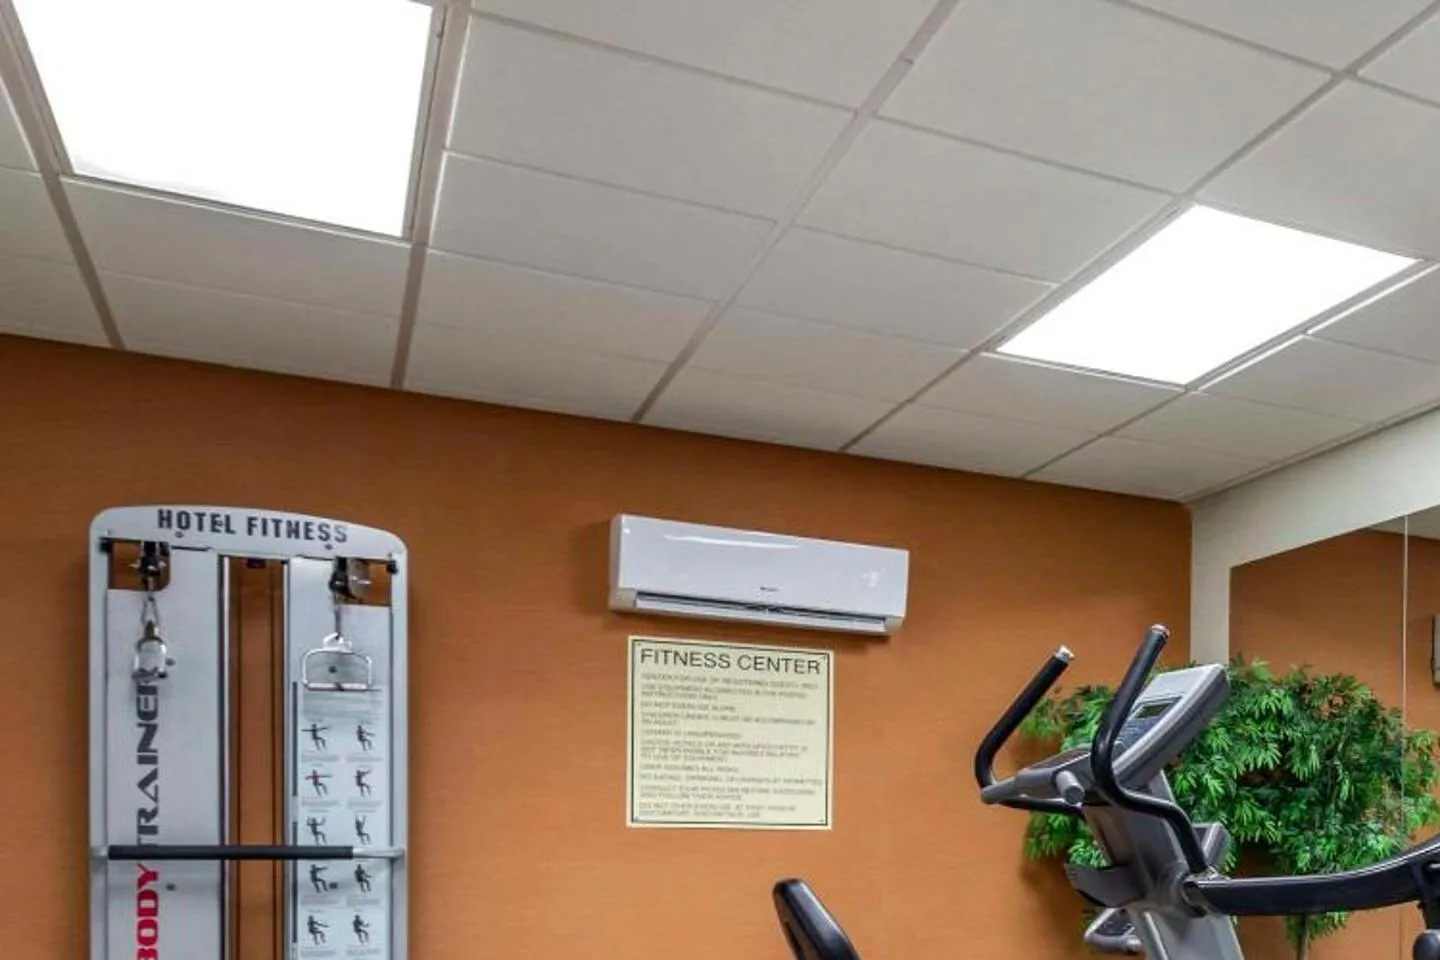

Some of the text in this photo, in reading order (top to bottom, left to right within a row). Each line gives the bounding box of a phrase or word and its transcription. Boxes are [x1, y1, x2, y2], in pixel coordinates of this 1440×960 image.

[157, 508, 349, 543] HOTEL FITNESS
[640, 648, 821, 675] FITNESS CENTER
